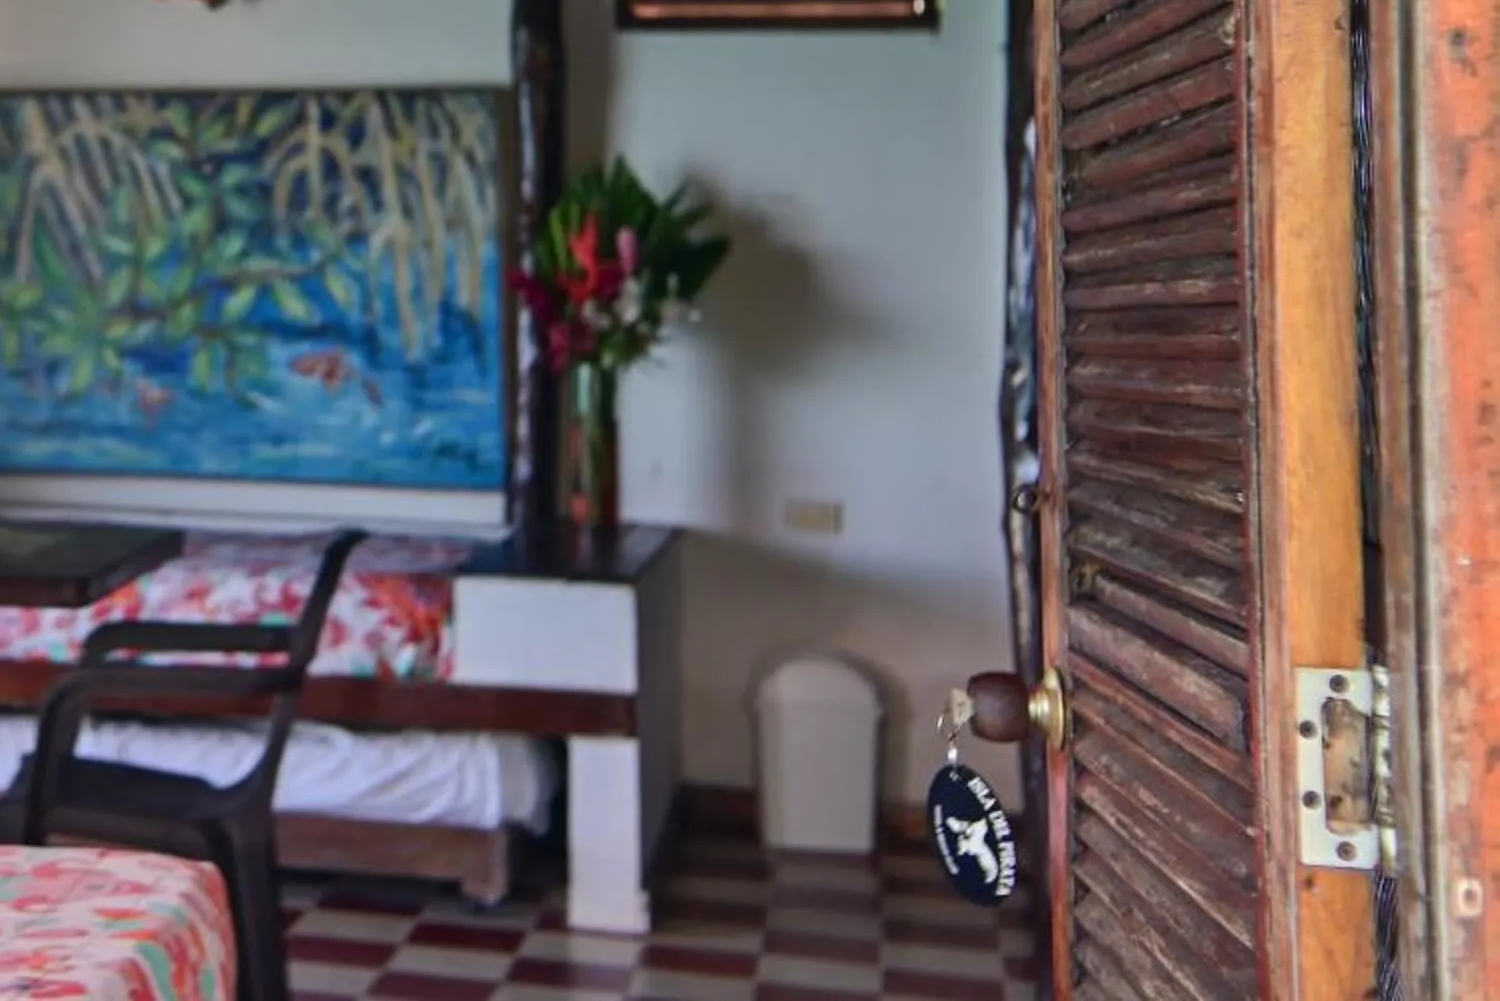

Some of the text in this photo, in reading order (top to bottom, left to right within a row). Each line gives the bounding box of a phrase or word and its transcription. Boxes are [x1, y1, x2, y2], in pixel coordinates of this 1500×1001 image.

[967, 776, 1017, 896] ISLA DEL PIRATA
